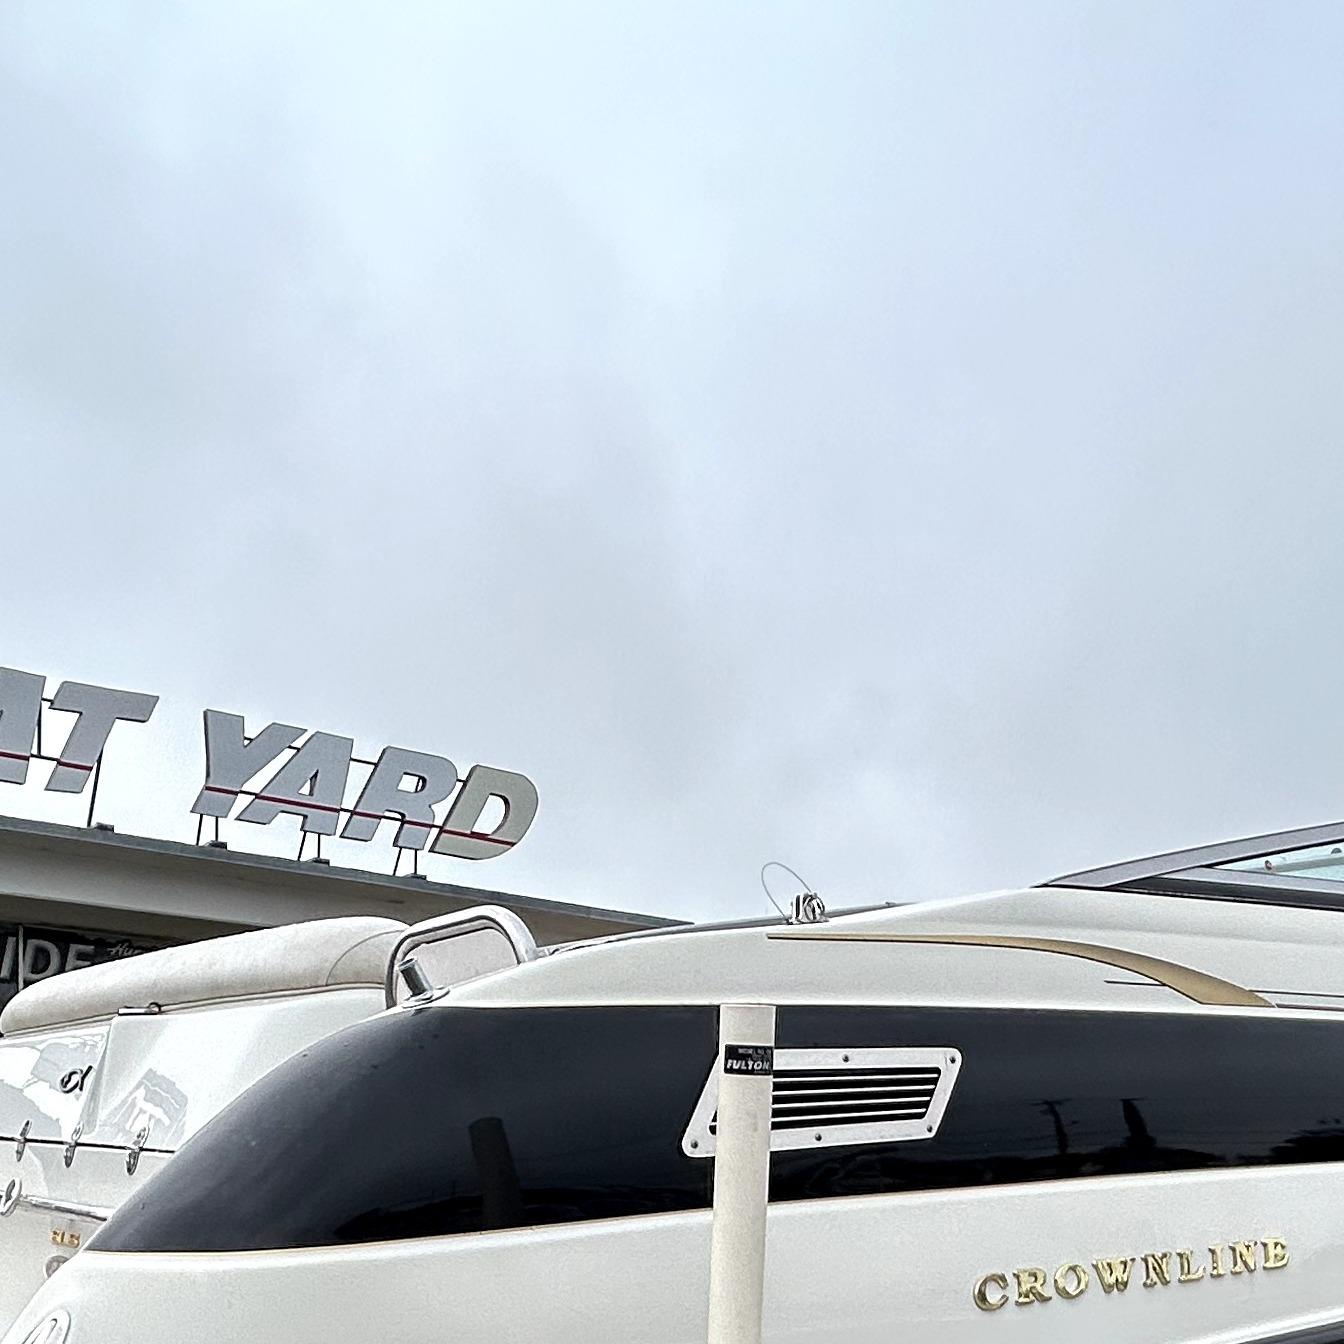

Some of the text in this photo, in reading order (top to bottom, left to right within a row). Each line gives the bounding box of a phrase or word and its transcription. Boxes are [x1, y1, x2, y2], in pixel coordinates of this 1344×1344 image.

[190, 707, 540, 861] YARD
[726, 1058, 770, 1070] FULTON
[972, 1236, 1292, 1312] CROWNLINE
